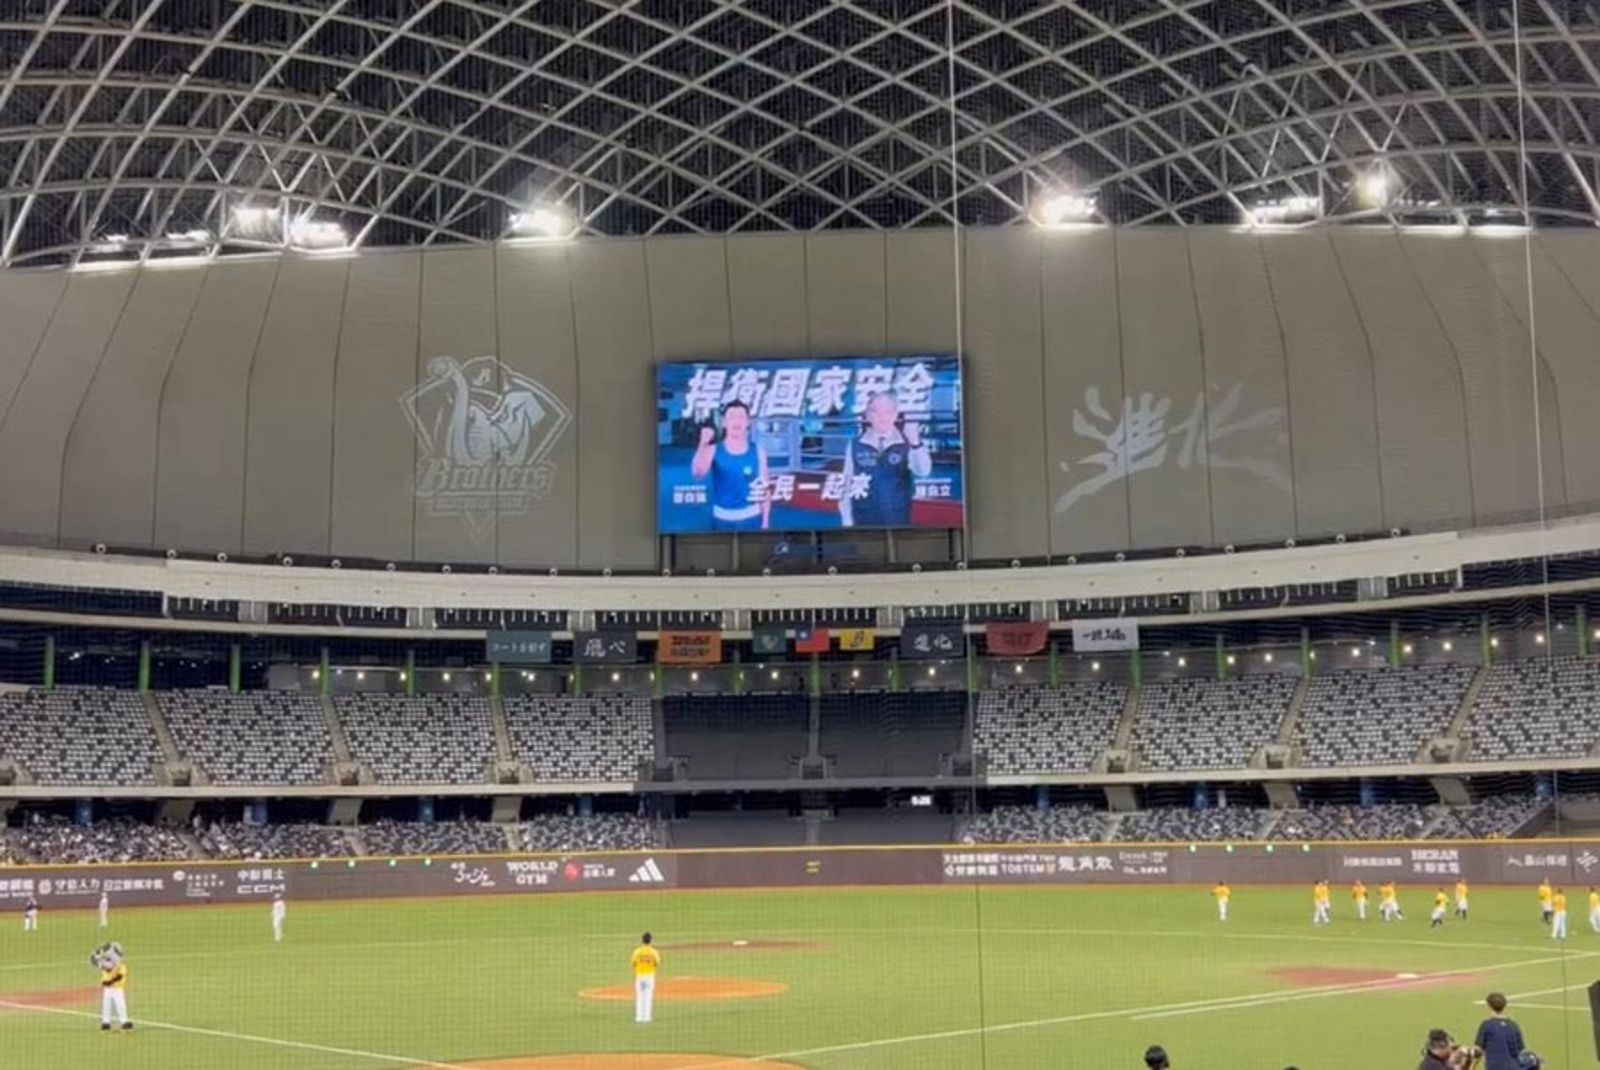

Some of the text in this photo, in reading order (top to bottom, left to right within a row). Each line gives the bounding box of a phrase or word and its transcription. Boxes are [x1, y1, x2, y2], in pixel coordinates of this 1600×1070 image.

[682, 363, 934, 421] 捍衛國家安全
[417, 457, 552, 491] Brothers
[747, 474, 872, 503] 全民一起來
[505, 861, 558, 874] WORLD
[516, 875, 547, 886] GYM
